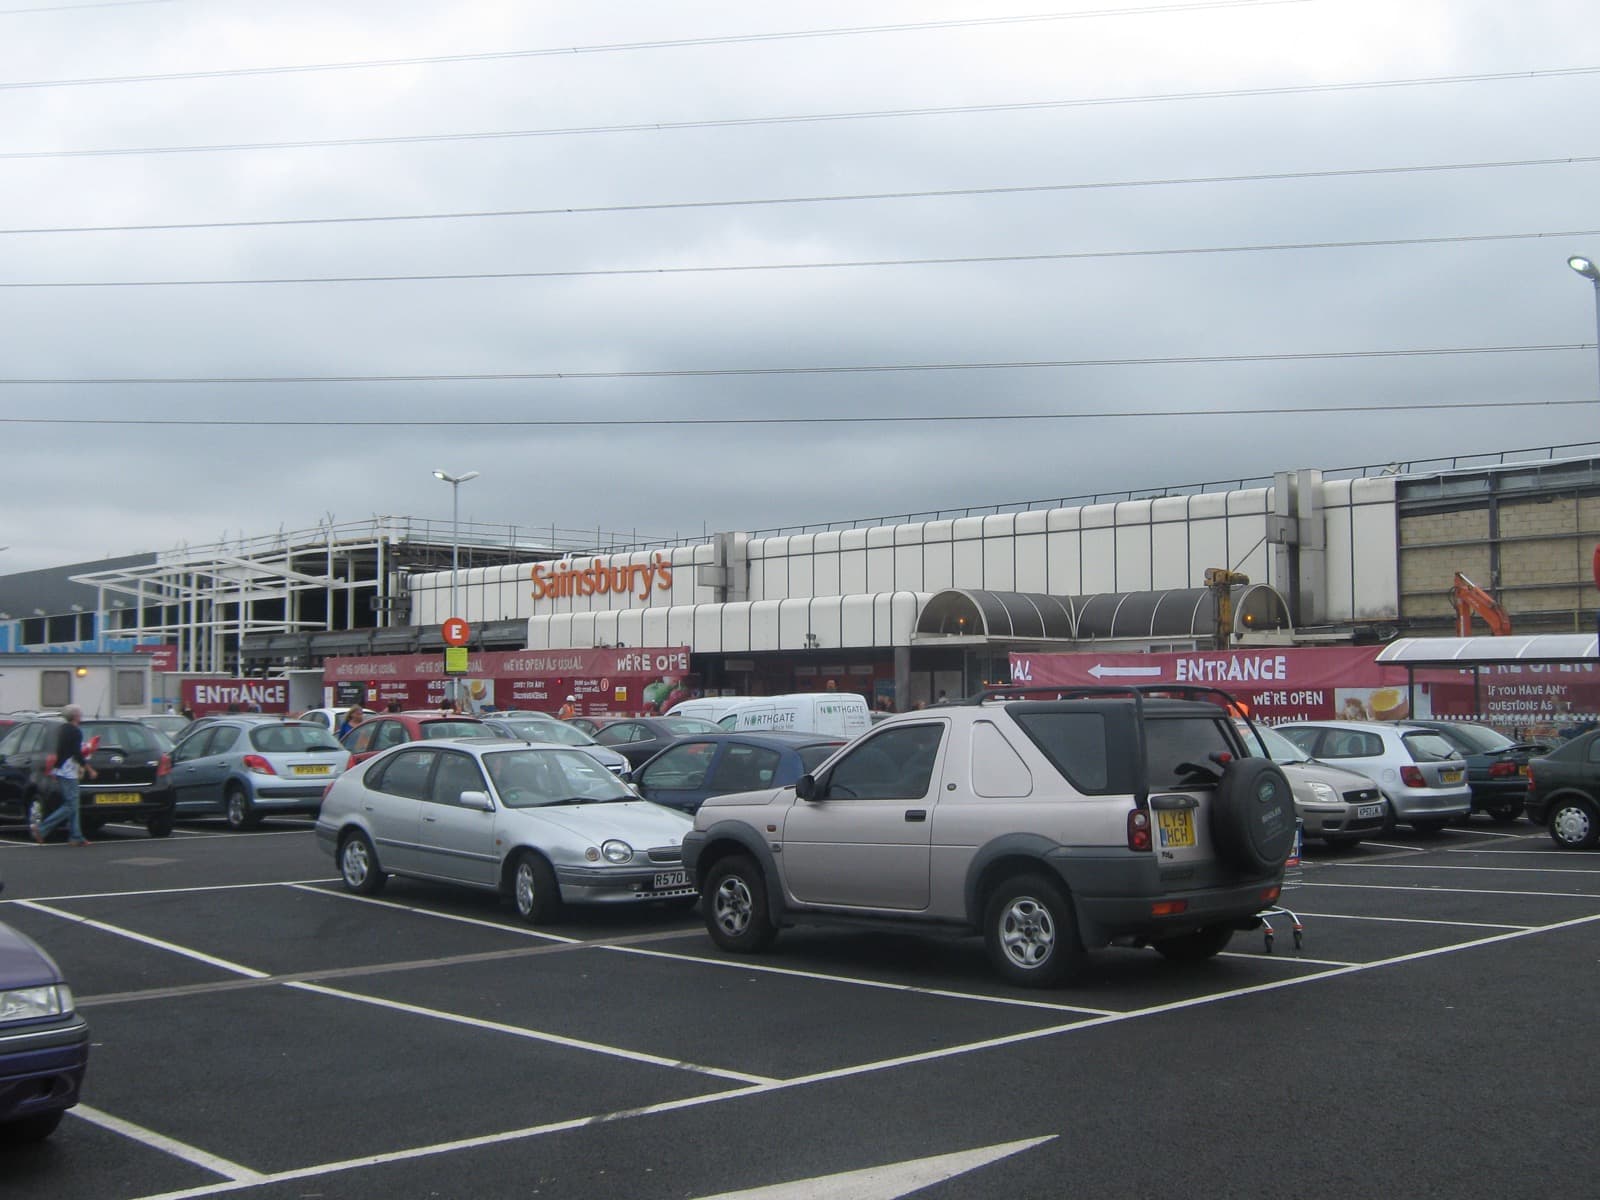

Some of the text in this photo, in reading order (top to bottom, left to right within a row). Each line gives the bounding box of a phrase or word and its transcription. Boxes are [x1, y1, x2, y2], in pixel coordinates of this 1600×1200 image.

[530, 553, 673, 601] Sainsbury's
[451, 624, 463, 640] E
[525, 657, 544, 671] OPEN
[546, 657, 557, 671] AS
[558, 655, 584, 670] USUAL
[617, 653, 687, 671] WE'RE OPE
[1175, 655, 1287, 681] ENTRANCE
[1010, 659, 1032, 681] AL
[195, 683, 285, 704] ENTRANCE
[1253, 690, 1323, 705] WE'RE OPEN
[1488, 684, 1568, 696] IF YOU HAVE ANY
[820, 704, 864, 715] NORTHGATE
[1488, 700, 1538, 711] QUESTIONS
[744, 712, 795, 726] NORTHGATE
[1167, 828, 1188, 843] HCH
[656, 871, 683, 886] R570
